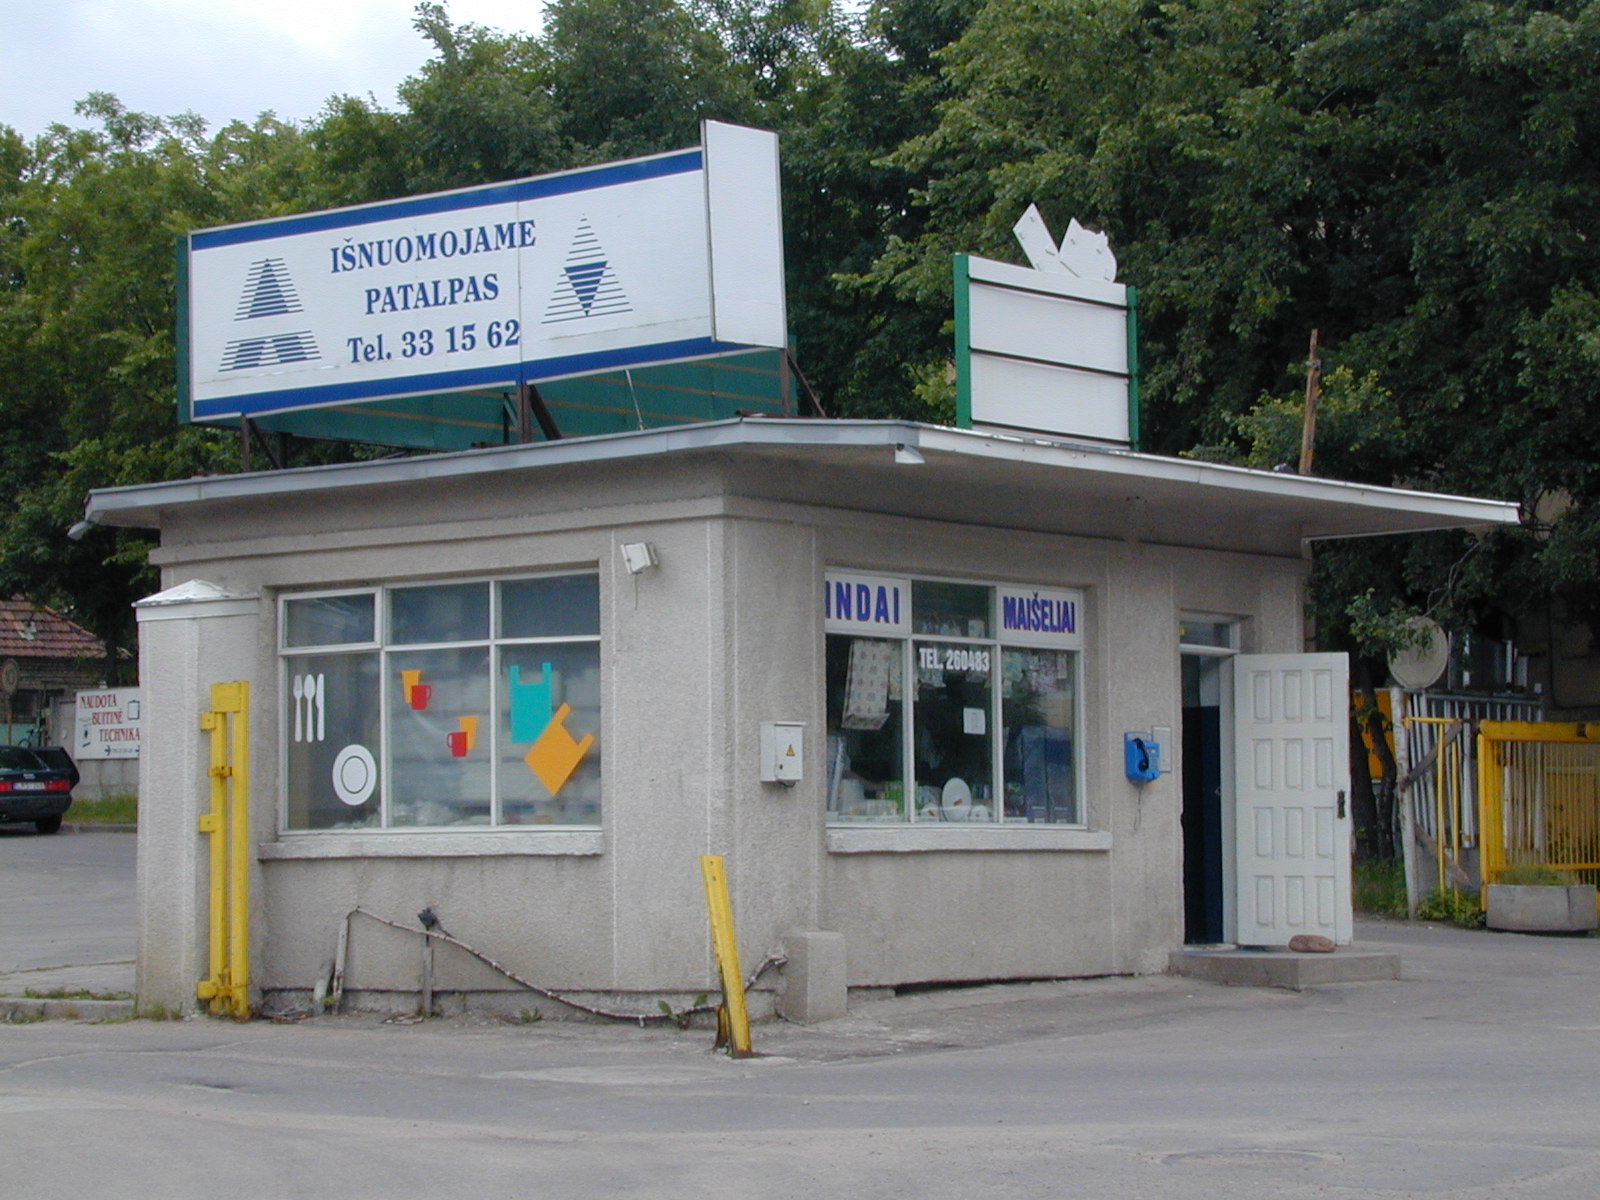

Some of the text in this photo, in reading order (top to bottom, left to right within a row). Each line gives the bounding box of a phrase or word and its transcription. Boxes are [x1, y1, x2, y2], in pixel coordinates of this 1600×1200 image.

[331, 219, 536, 273] IŠNUOMOJAME
[365, 273, 499, 315] PATALPAS
[347, 319, 520, 363] Tel. 33 15 62
[825, 580, 899, 624] INDAI
[1003, 592, 1075, 633] MAIŠELIAI
[919, 647, 990, 672] TEL. 260483
[81, 694, 117, 709] NAUDOTA
[99, 728, 140, 742] TECHNIKA
